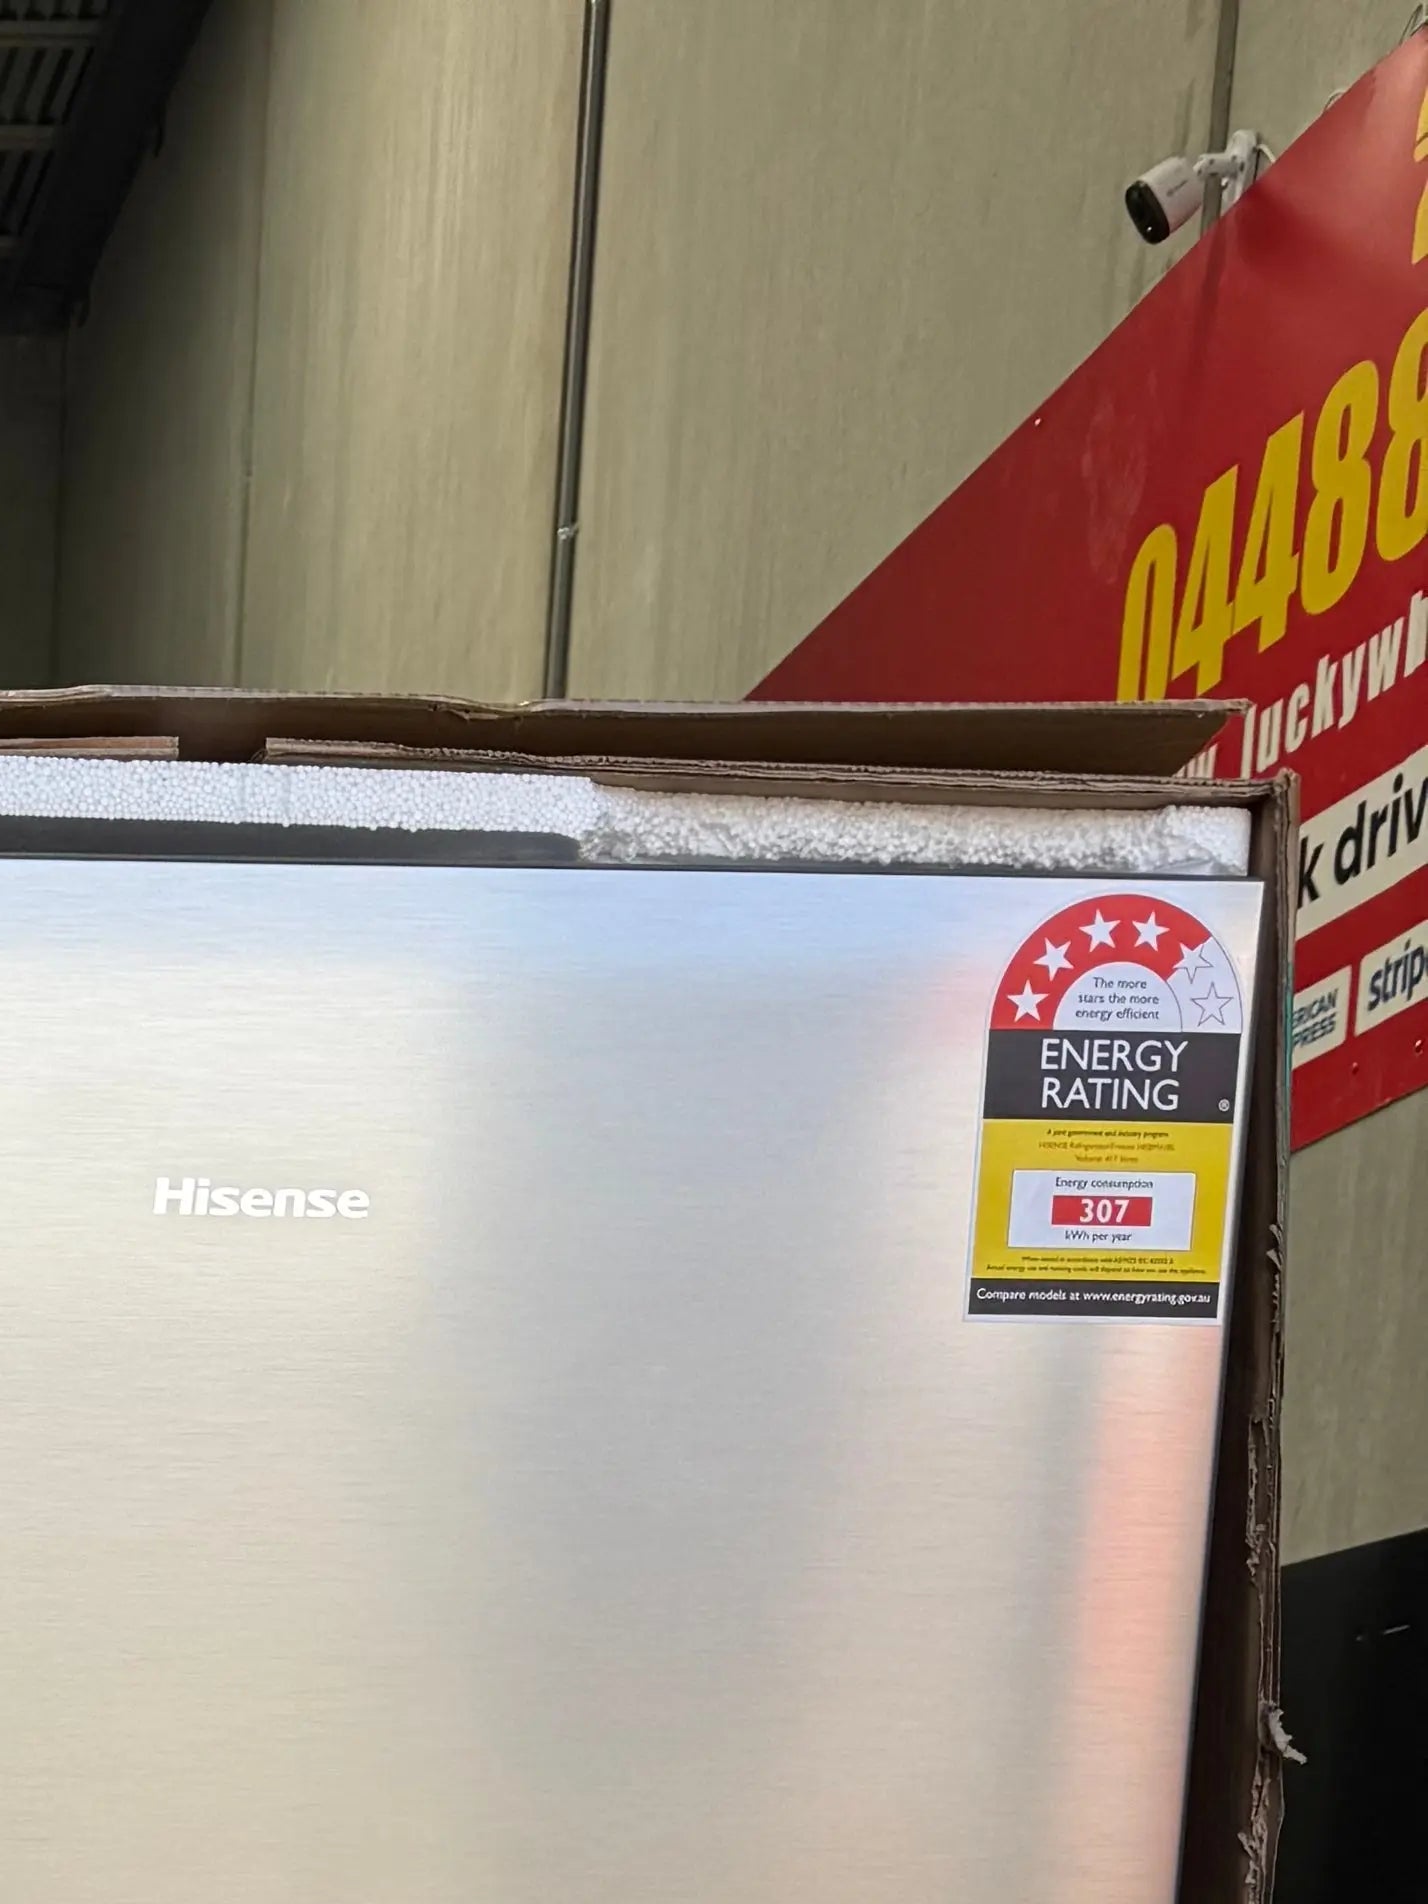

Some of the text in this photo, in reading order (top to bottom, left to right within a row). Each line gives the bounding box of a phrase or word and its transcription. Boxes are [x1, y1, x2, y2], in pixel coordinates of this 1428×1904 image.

[1093, 977, 1147, 989] The more
[1078, 993, 1159, 1004] stars the more
[1075, 1008, 1159, 1022] energy efficient
[1040, 1038, 1189, 1072] ENERGY
[1041, 1078, 1180, 1110] RATING
[1055, 1177, 1154, 1190] Energy consumption
[153, 1177, 370, 1218] Hisense
[1079, 1199, 1130, 1224] 307
[1065, 1230, 1132, 1242] kWh per year
[977, 1288, 1211, 1305] Compare models at www.energyrating.gov.au
